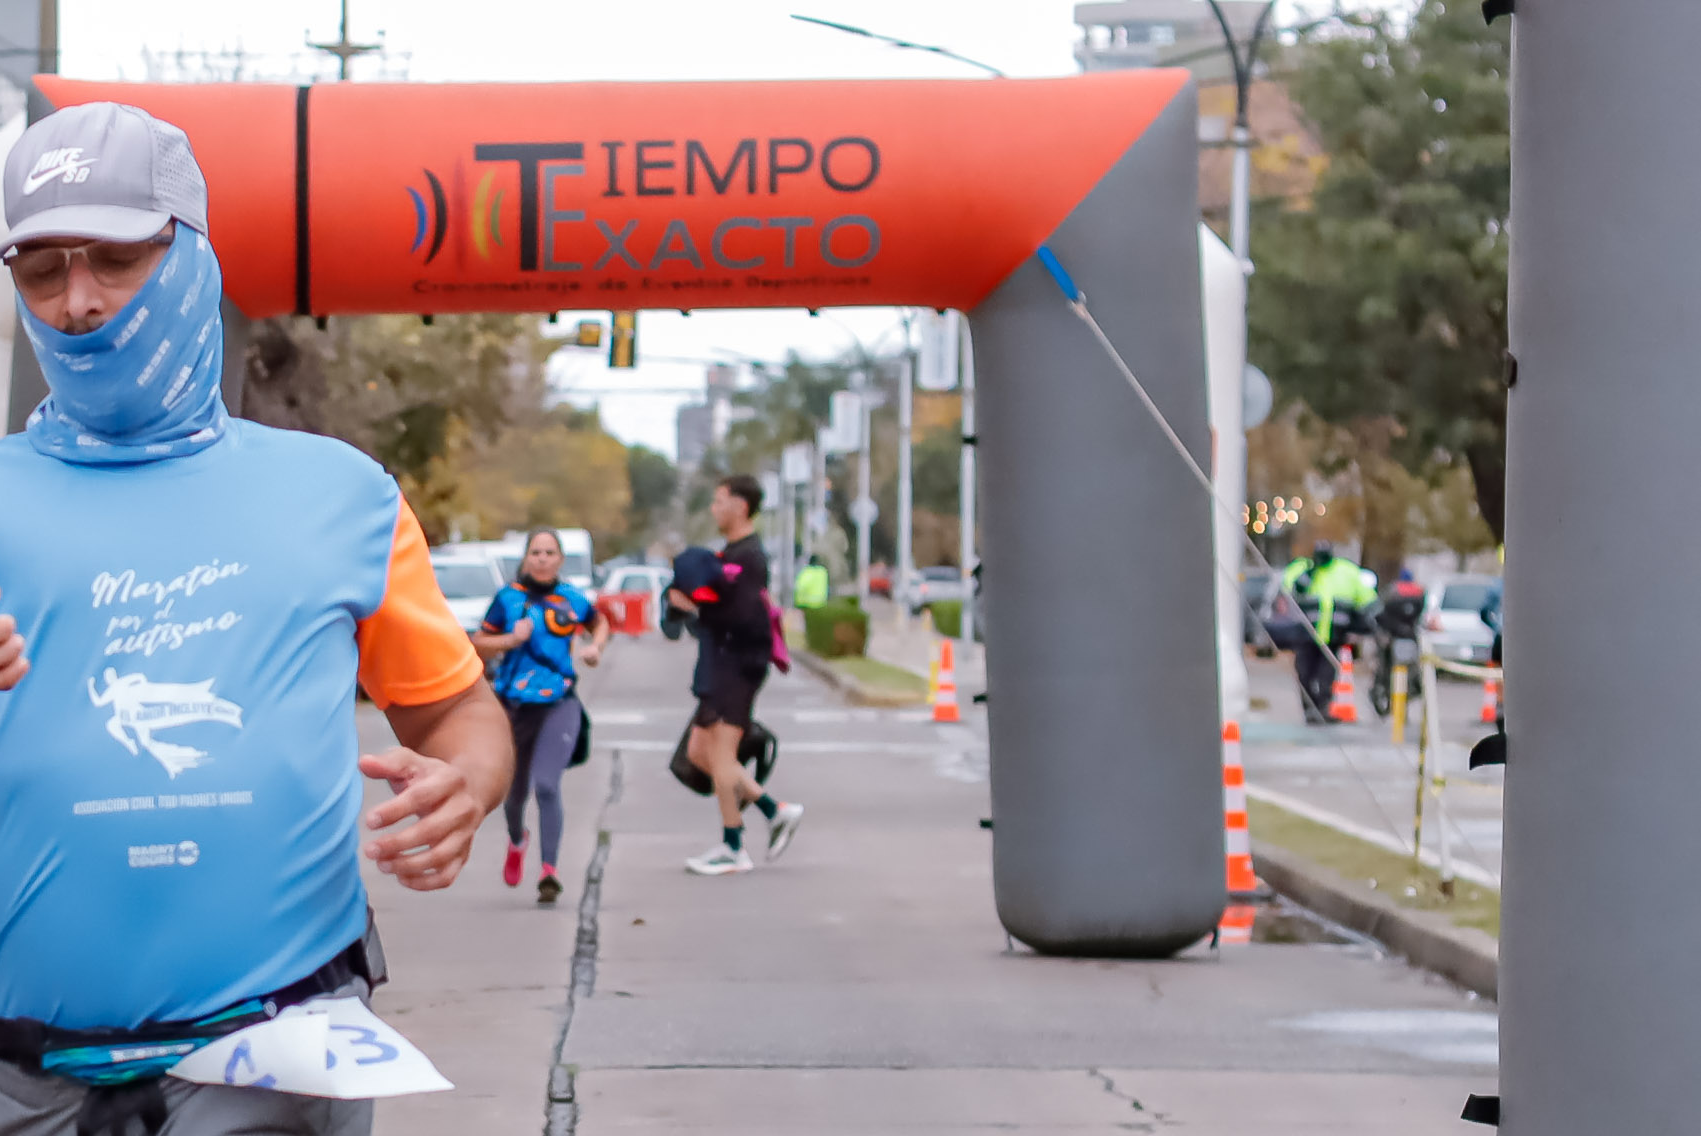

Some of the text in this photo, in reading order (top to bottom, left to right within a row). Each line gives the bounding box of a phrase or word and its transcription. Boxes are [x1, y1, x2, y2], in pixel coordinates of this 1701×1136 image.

[32, 147, 85, 174] NIKE
[61, 165, 91, 184] SB
[474, 137, 881, 271] TIEMPO
[543, 164, 882, 271] EXACTO
[91, 558, 248, 608] Maratón
[104, 610, 243, 657] autismo
[106, 598, 175, 637] por el
